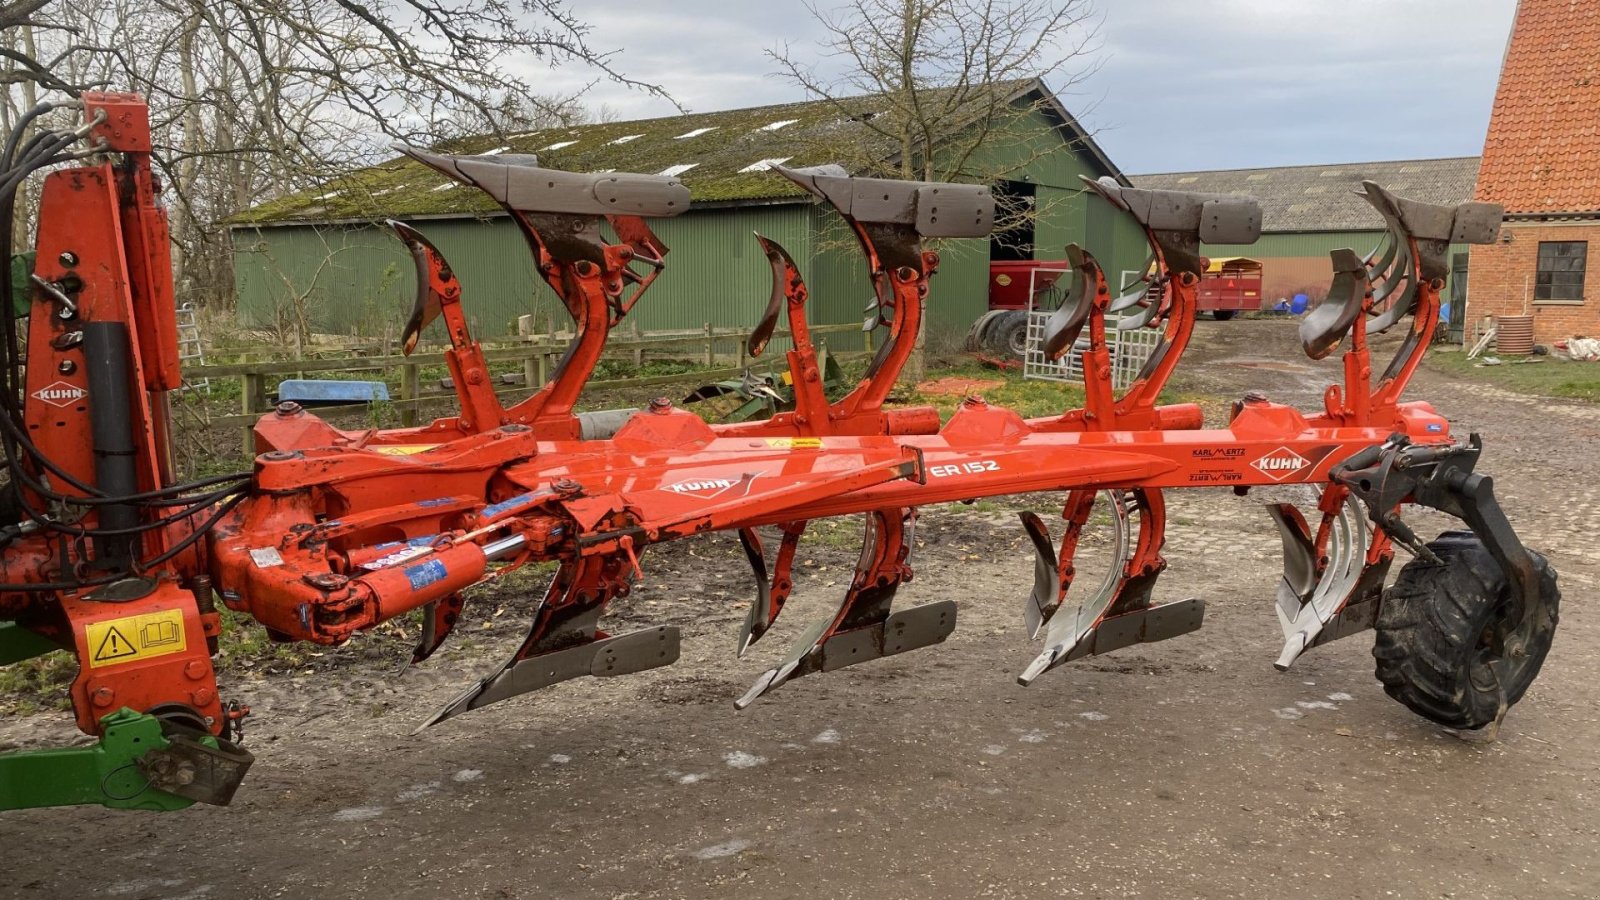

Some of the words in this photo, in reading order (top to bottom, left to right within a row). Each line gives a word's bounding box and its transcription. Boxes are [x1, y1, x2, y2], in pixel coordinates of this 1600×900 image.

[40, 389, 82, 400] KUHN
[1192, 449, 1212, 457] KARL
[1212, 448, 1246, 457] MERTZ
[924, 464, 962, 477] ER
[962, 460, 1001, 474] 152
[1259, 457, 1302, 470] KUHN
[671, 479, 731, 493] KUHN
